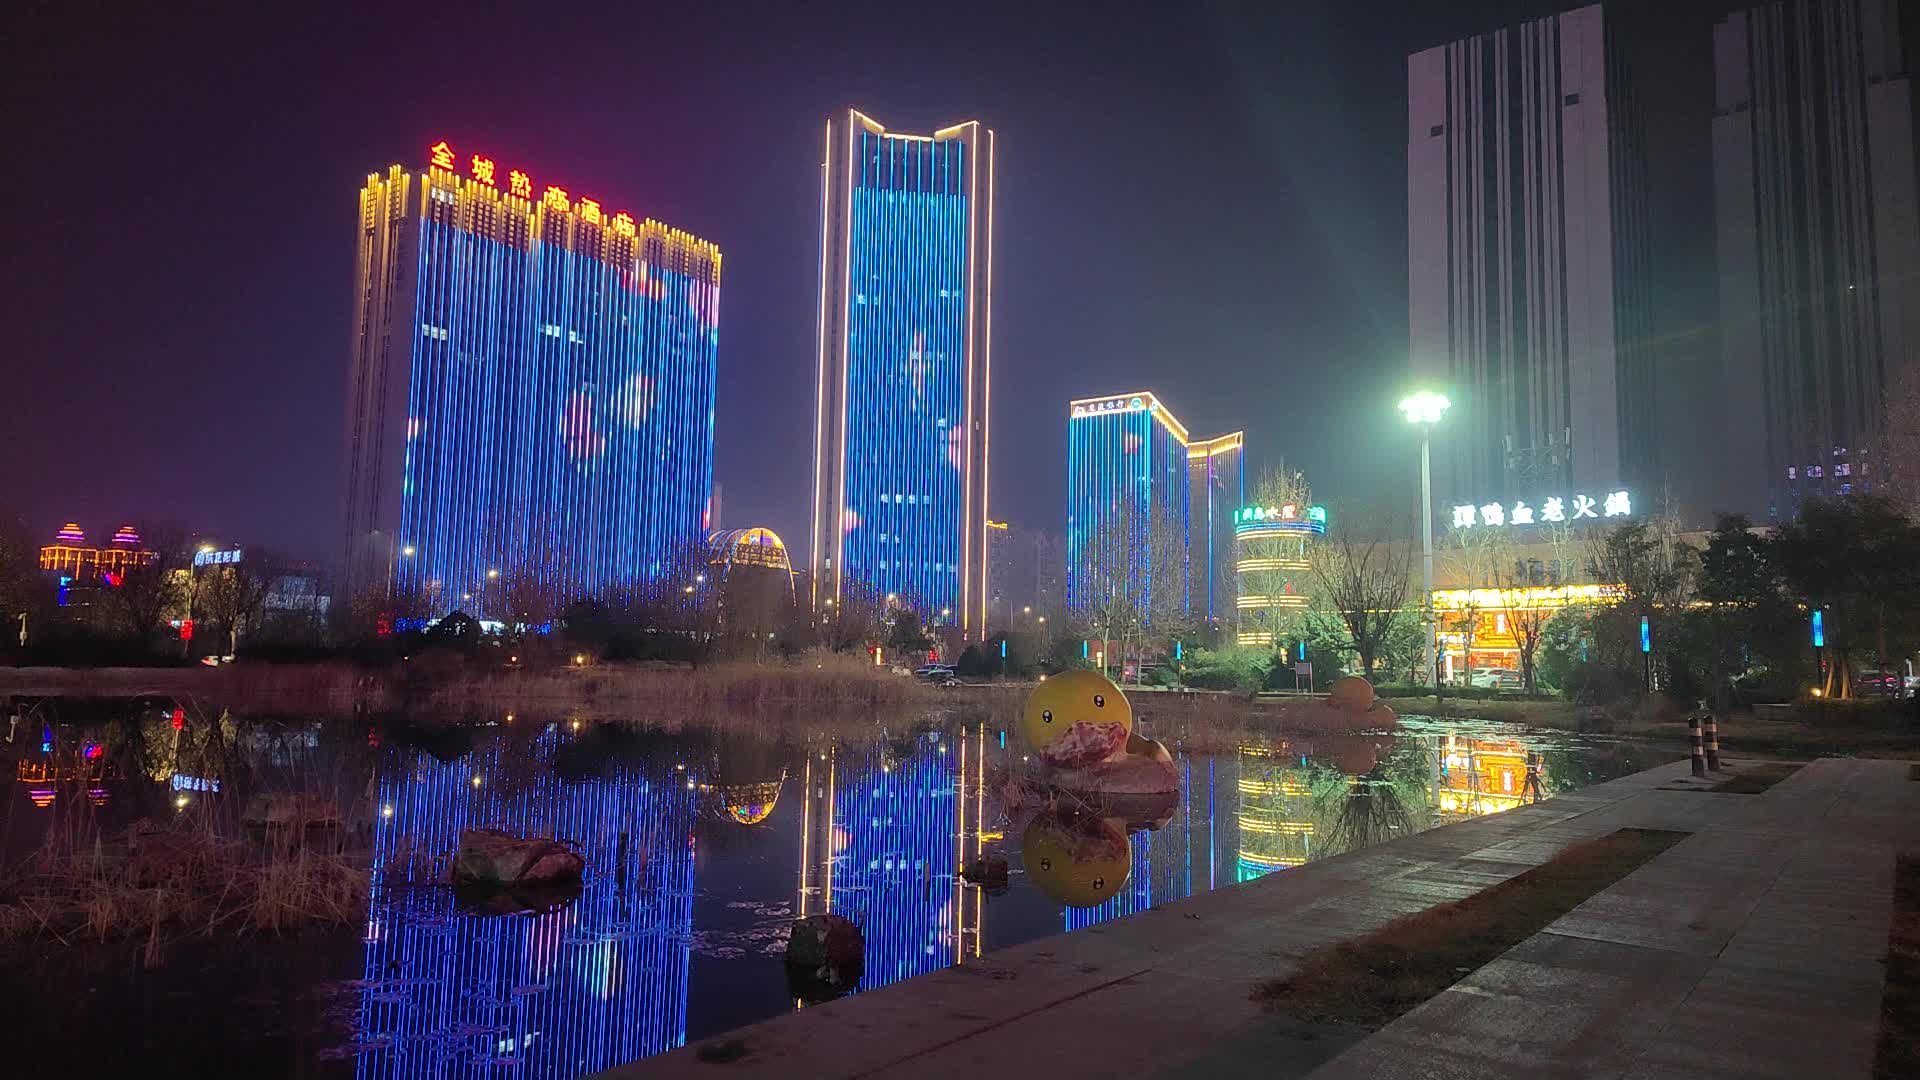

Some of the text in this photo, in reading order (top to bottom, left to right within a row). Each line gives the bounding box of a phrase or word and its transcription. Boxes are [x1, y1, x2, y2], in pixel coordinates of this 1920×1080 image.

[430, 140, 636, 237] 全城热恋酒店
